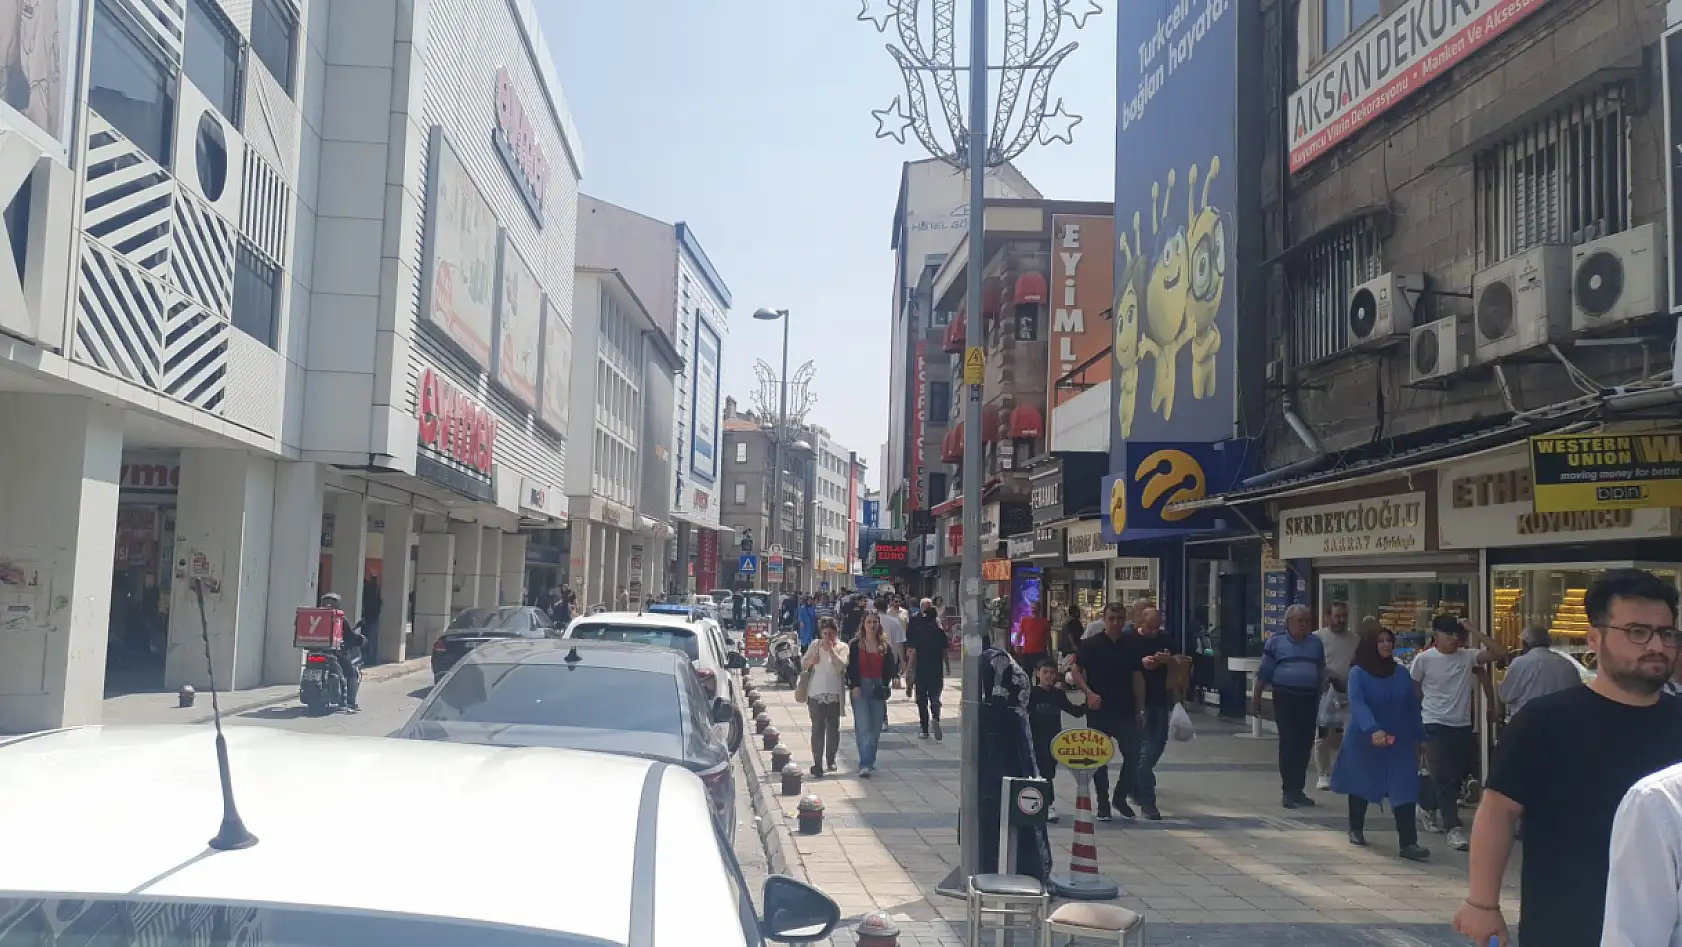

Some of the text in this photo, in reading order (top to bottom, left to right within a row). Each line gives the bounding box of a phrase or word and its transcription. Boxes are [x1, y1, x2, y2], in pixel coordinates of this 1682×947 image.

[1138, 0, 1189, 73] Turkcell
[1292, 0, 1535, 165] Kuyumcu Vitrin Dekorasyonu Manken Ve Aksesu
[1123, 64, 1164, 131] bağlan
[1537, 437, 1631, 454] WESTERN
[1567, 450, 1632, 467] UNION
[1559, 466, 1681, 481] moving money for better
[1285, 498, 1421, 544] ŞERBETCİOĞLU
[1061, 730, 1105, 746] YEŞİM
[1057, 745, 1108, 756] GELİNLİK
